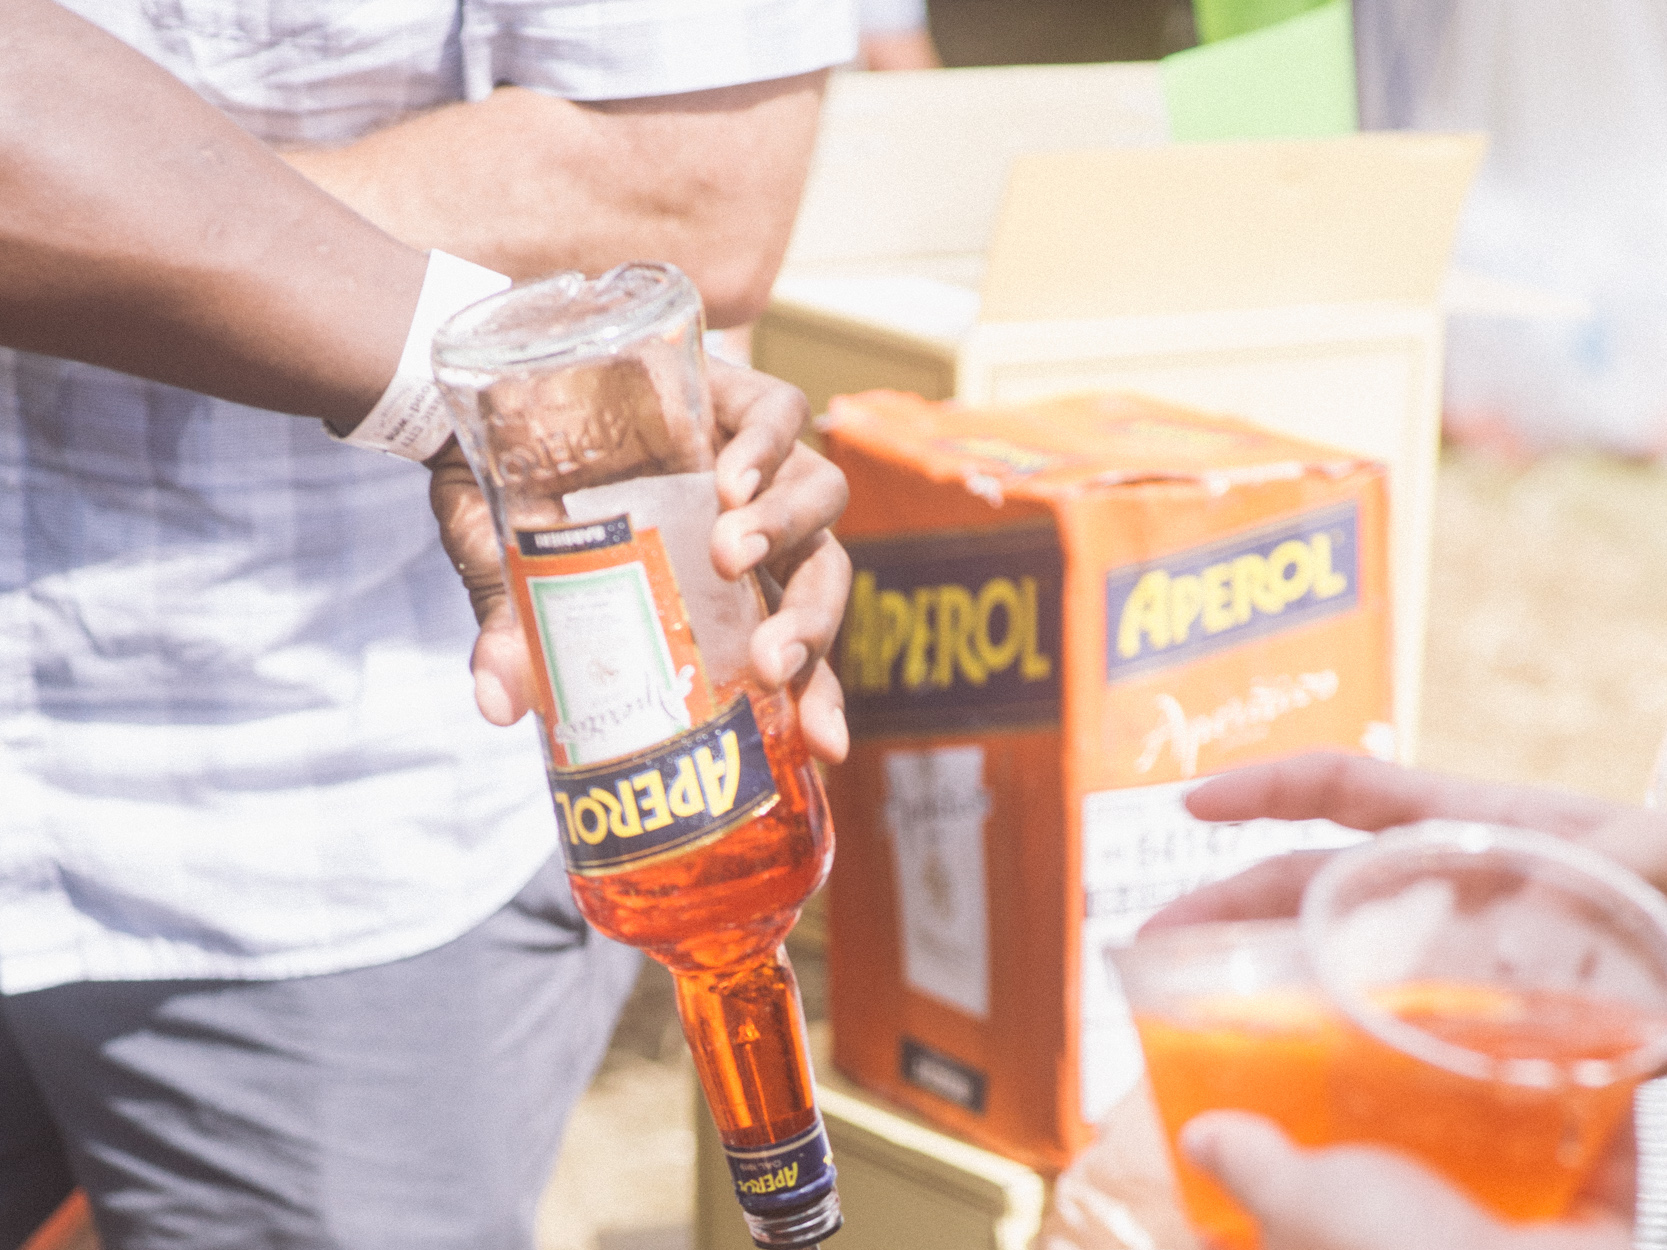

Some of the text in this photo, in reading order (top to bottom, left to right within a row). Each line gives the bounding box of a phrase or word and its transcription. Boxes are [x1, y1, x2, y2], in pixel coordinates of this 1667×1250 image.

[848, 569, 1050, 692] APEROL
[1117, 533, 1347, 659] APEROL
[555, 729, 741, 845] APEROL
